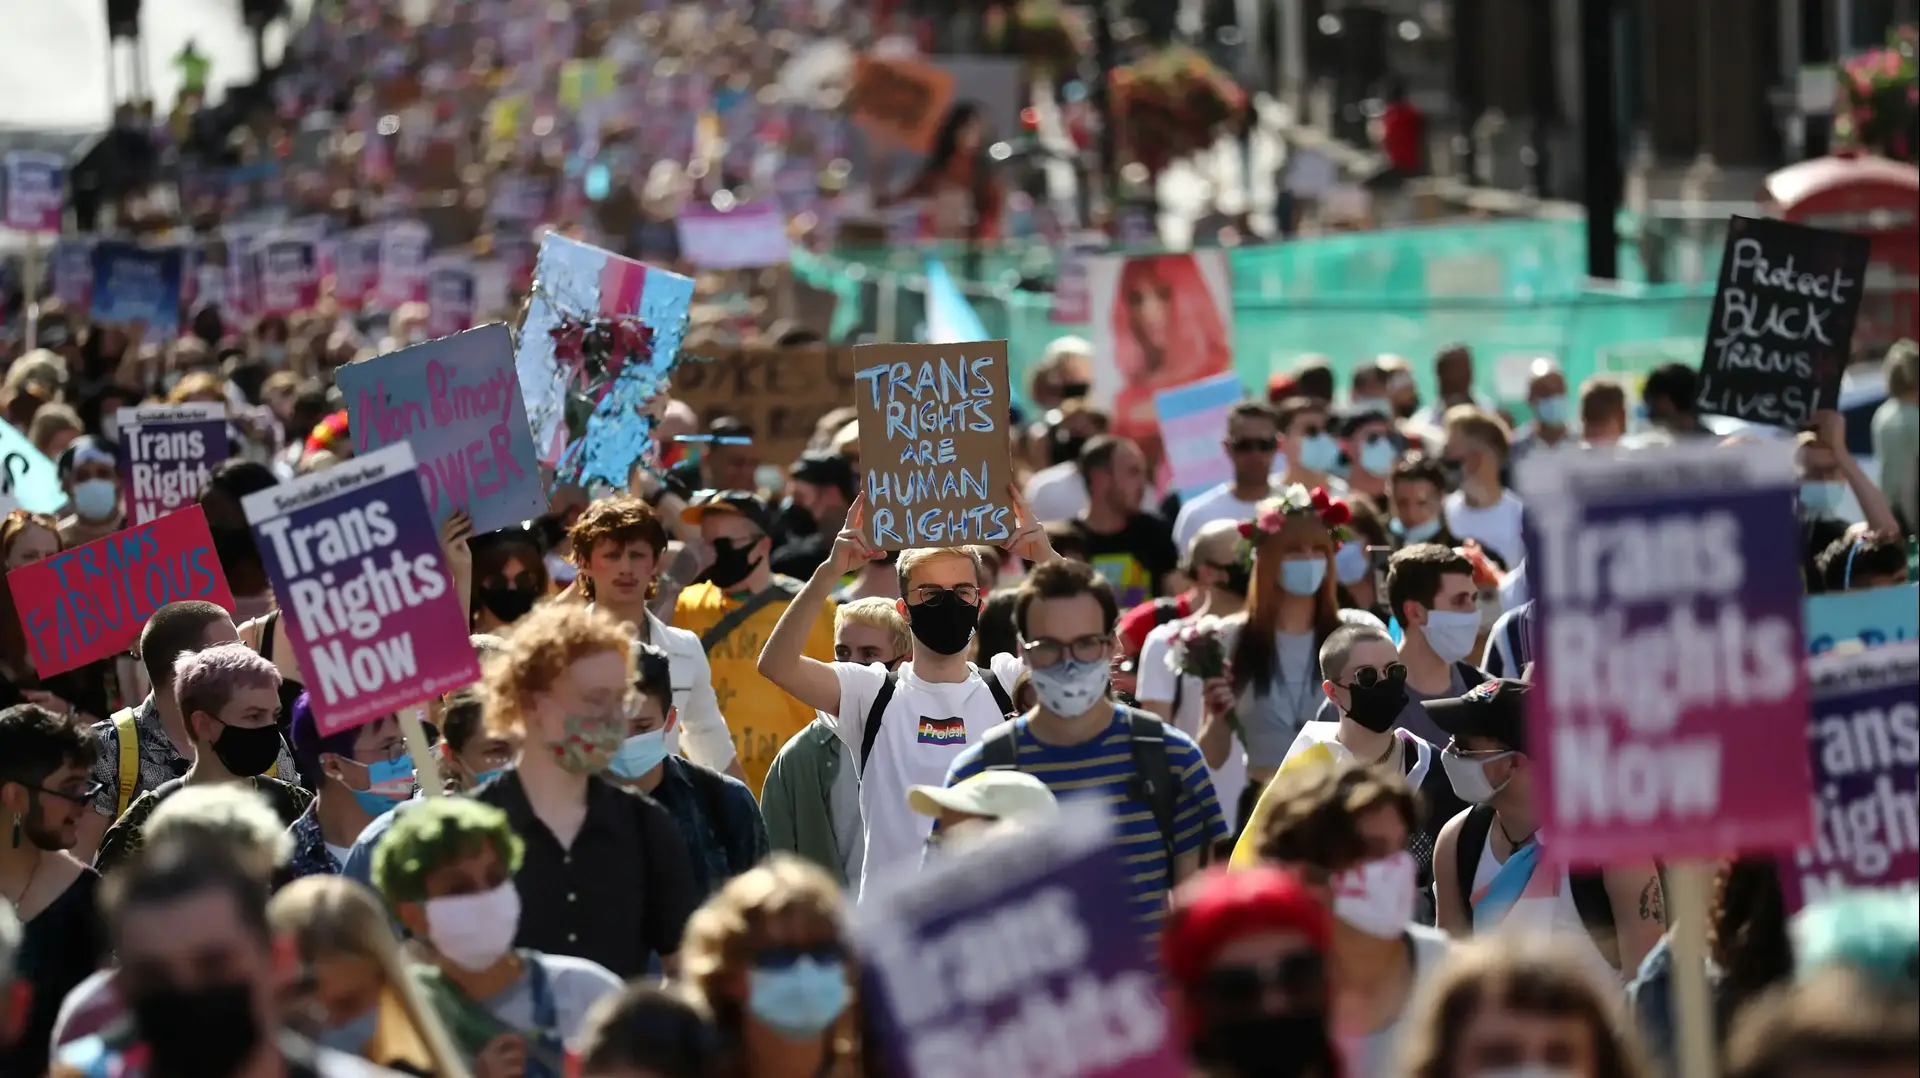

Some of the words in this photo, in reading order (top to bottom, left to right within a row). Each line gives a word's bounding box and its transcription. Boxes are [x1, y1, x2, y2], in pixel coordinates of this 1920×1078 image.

[358, 379, 427, 451] Non
[426, 358, 518, 427] Binary
[855, 354, 994, 412] TRANS
[123, 426, 206, 461] Trans
[886, 399, 995, 440] RIGHTS
[900, 438, 957, 466] ARE
[132, 461, 211, 507] Right
[336, 463, 386, 489] Worker
[417, 423, 525, 513] OWER
[868, 461, 988, 507] HUMAN
[46, 526, 159, 589] TRANS
[259, 500, 397, 579] Trans
[872, 503, 1010, 547] RIGHTS
[1534, 498, 1744, 602] Trans
[25, 547, 215, 664] FABULOUS
[289, 550, 447, 642] Rights
[310, 631, 417, 705] Now
[1546, 602, 1797, 733] Rights
[923, 722, 963, 740] Protest
[1806, 702, 1919, 775] ans
[1550, 726, 1723, 830] Now
